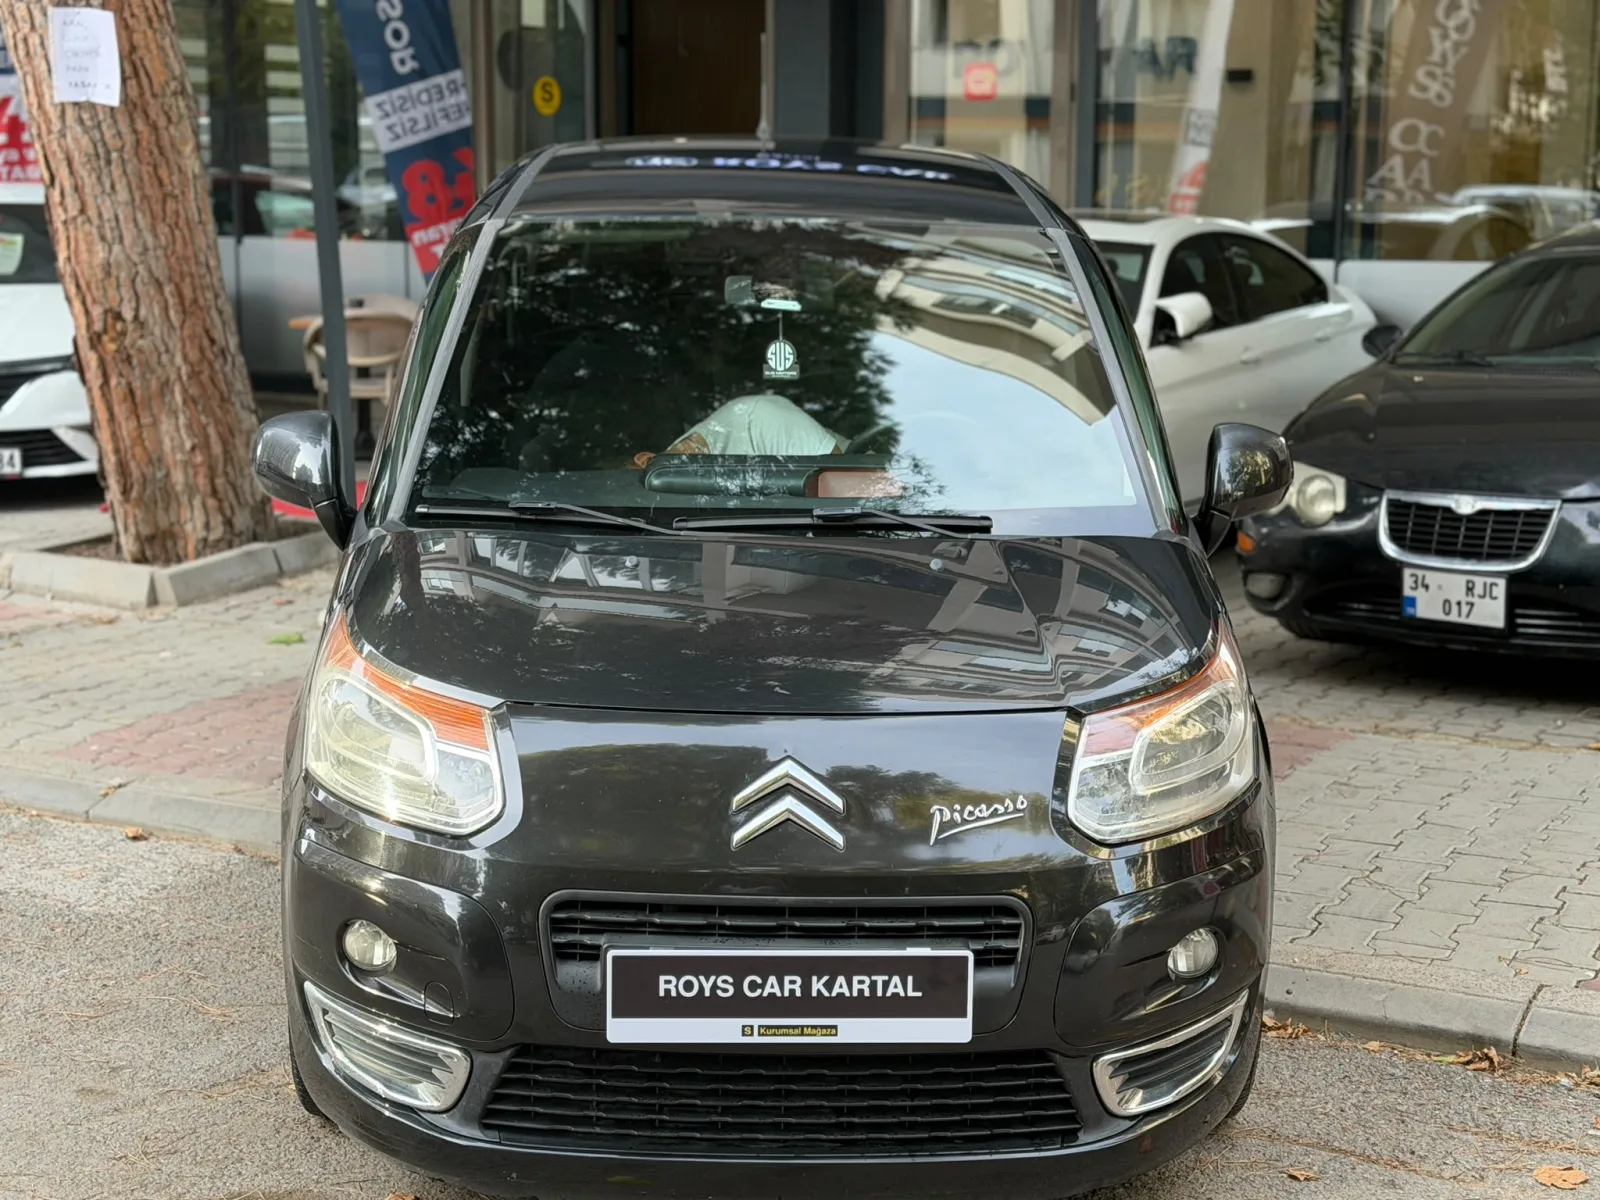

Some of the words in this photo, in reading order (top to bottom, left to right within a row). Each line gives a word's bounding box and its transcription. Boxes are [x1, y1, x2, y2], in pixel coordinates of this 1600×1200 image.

[767, 342, 794, 371] SUS
[1408, 573, 1430, 593] 34
[1465, 579, 1499, 601] RJC
[1442, 598, 1475, 620] 017
[658, 975, 735, 998] ROYS
[742, 975, 803, 998] CAR
[811, 975, 923, 997] KARTAL
[743, 1026, 752, 1035] S
[760, 1026, 801, 1035] Kurumsal
[804, 1026, 836, 1036] Mağaza
